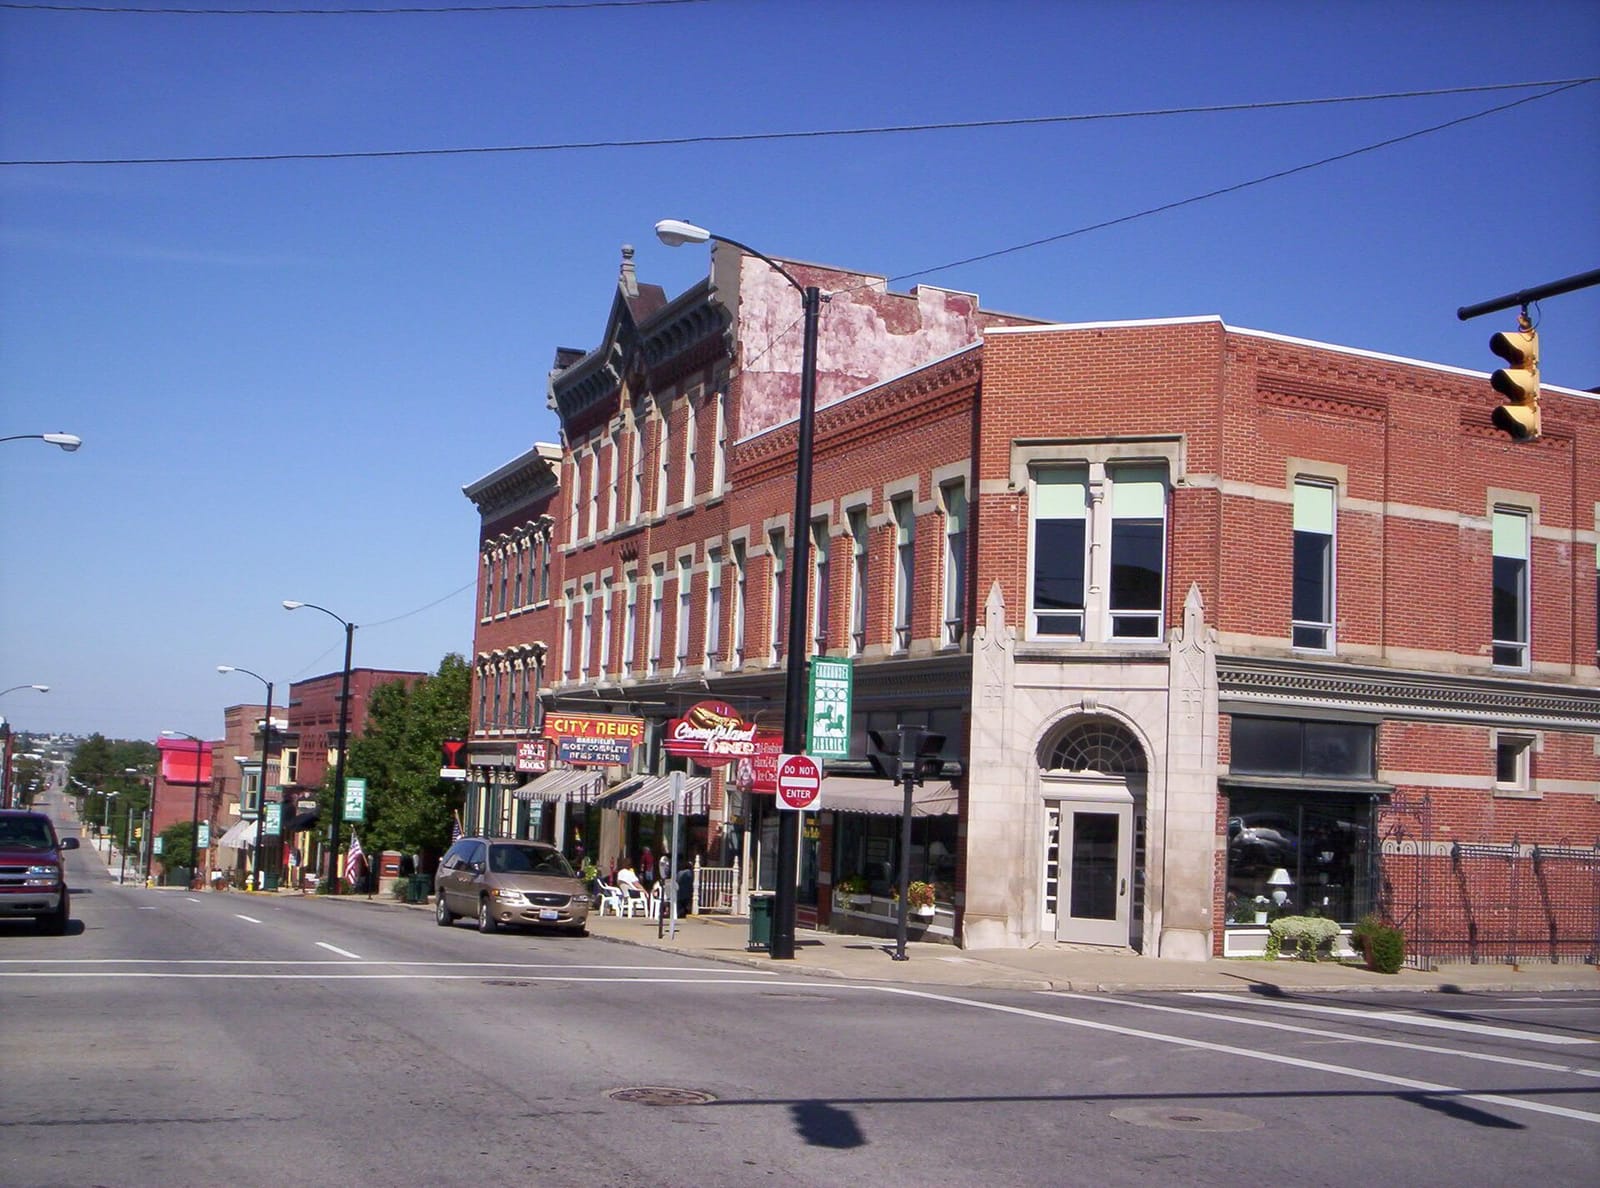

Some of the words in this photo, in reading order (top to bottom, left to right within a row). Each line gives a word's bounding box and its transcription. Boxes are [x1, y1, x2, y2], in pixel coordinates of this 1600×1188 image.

[554, 720, 590, 733] CITY
[596, 722, 639, 736] NEWS
[562, 743, 586, 751] MOST
[588, 745, 628, 753] COMPLETE
[707, 741, 755, 754] DINER
[519, 759, 546, 770] BOOKS
[784, 764, 796, 775] DO
[799, 765, 816, 776] NOT
[786, 788, 812, 799] ENTER
